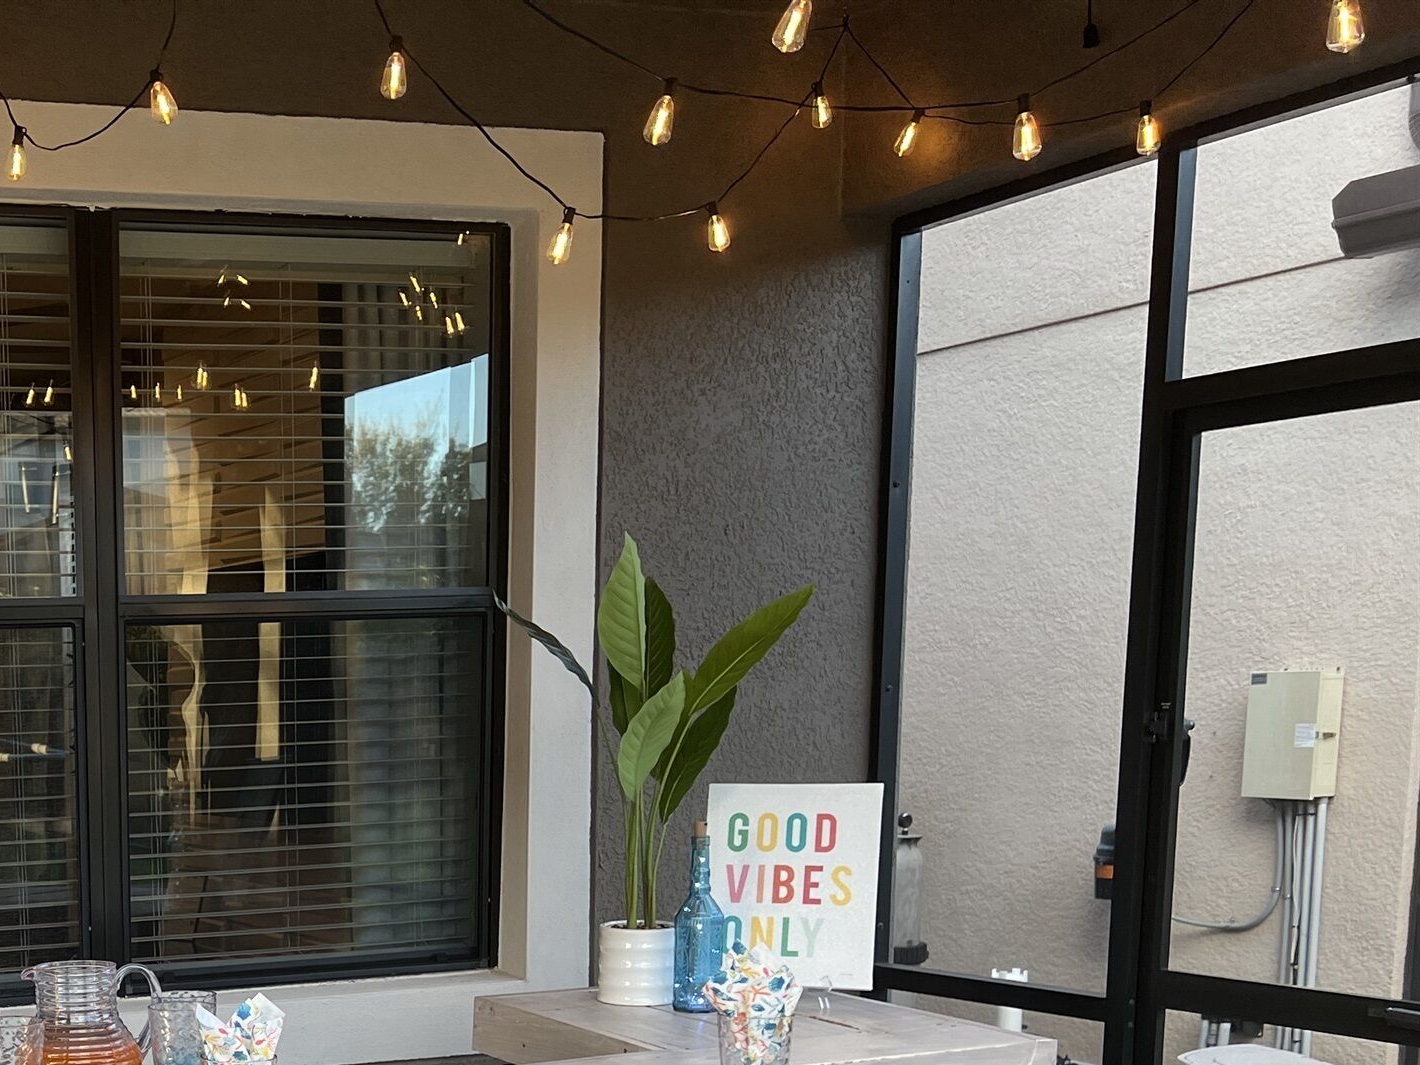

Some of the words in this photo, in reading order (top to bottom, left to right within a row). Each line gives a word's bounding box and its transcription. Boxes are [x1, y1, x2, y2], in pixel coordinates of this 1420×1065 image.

[727, 812, 837, 853] GOOD
[726, 864, 852, 906] VIBES
[723, 915, 824, 958] ONLY
